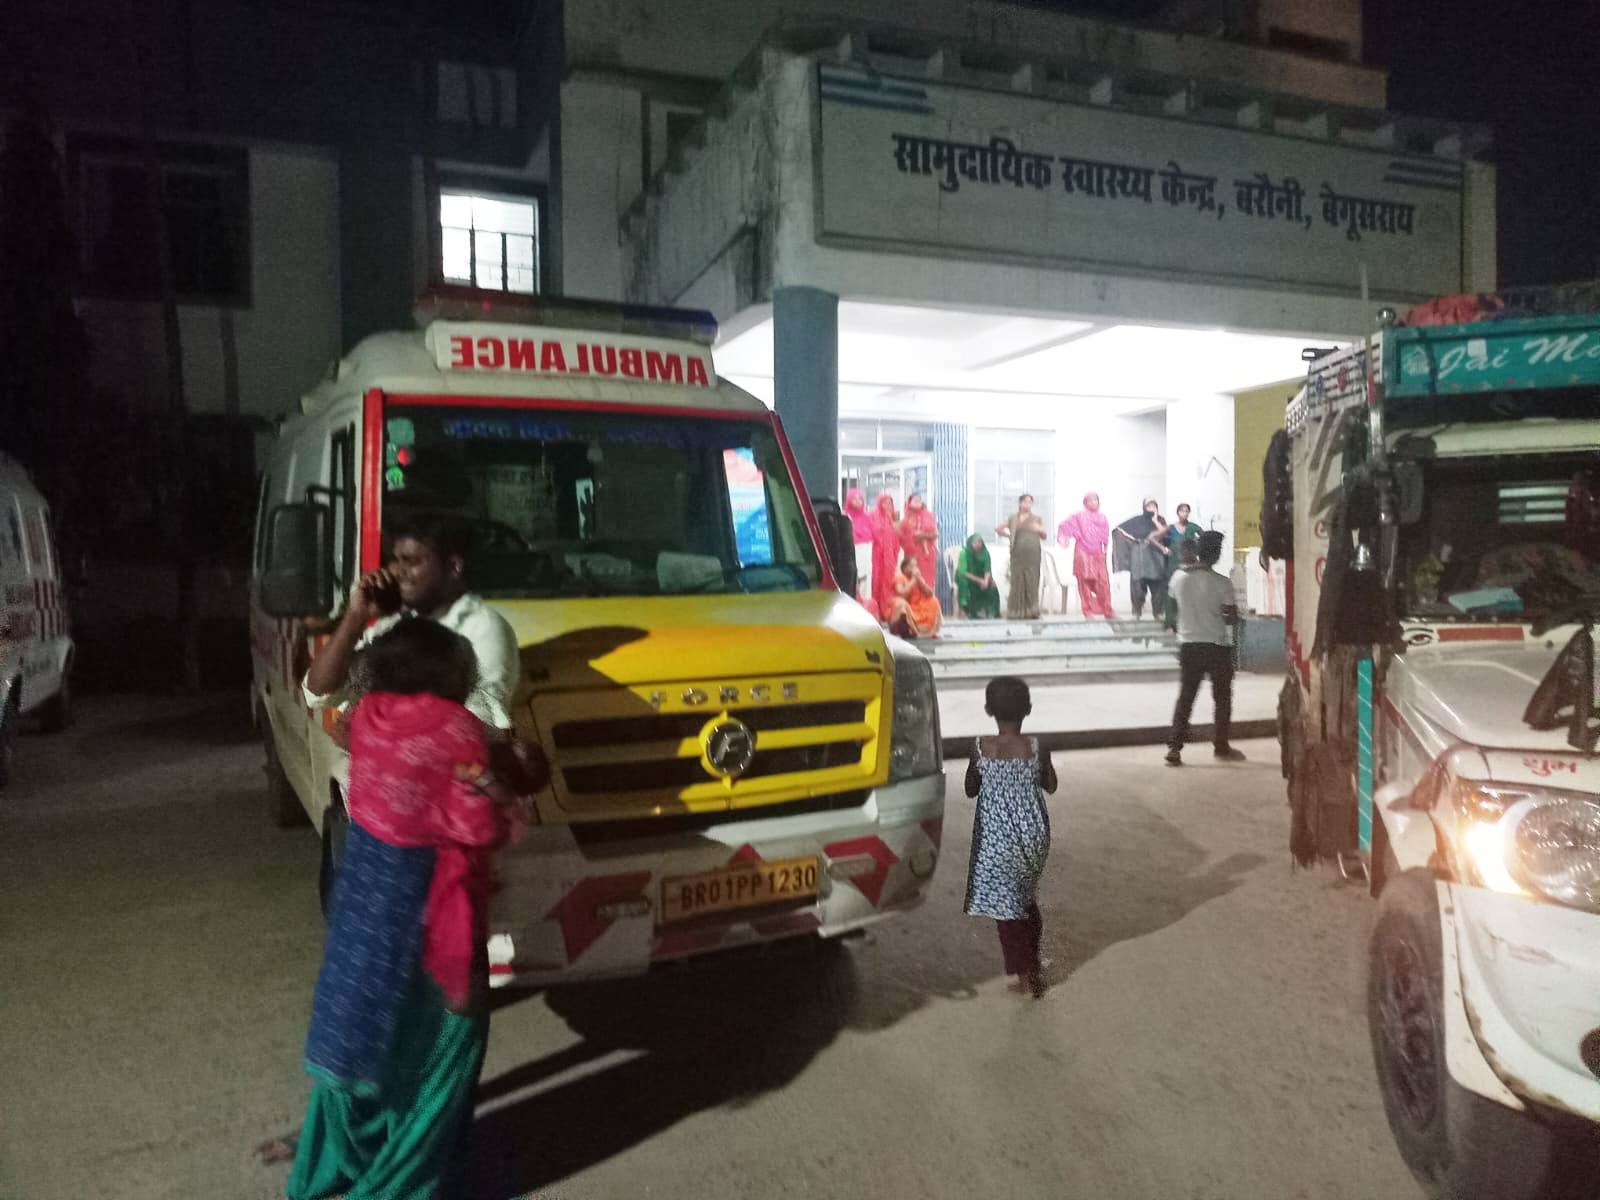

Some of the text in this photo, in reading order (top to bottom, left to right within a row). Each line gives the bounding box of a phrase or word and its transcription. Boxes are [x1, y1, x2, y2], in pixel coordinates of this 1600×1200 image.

[891, 133, 1054, 192] सामुदायिक
[1319, 181, 1415, 241] बेगूसराय
[652, 682, 797, 710] FORCE
